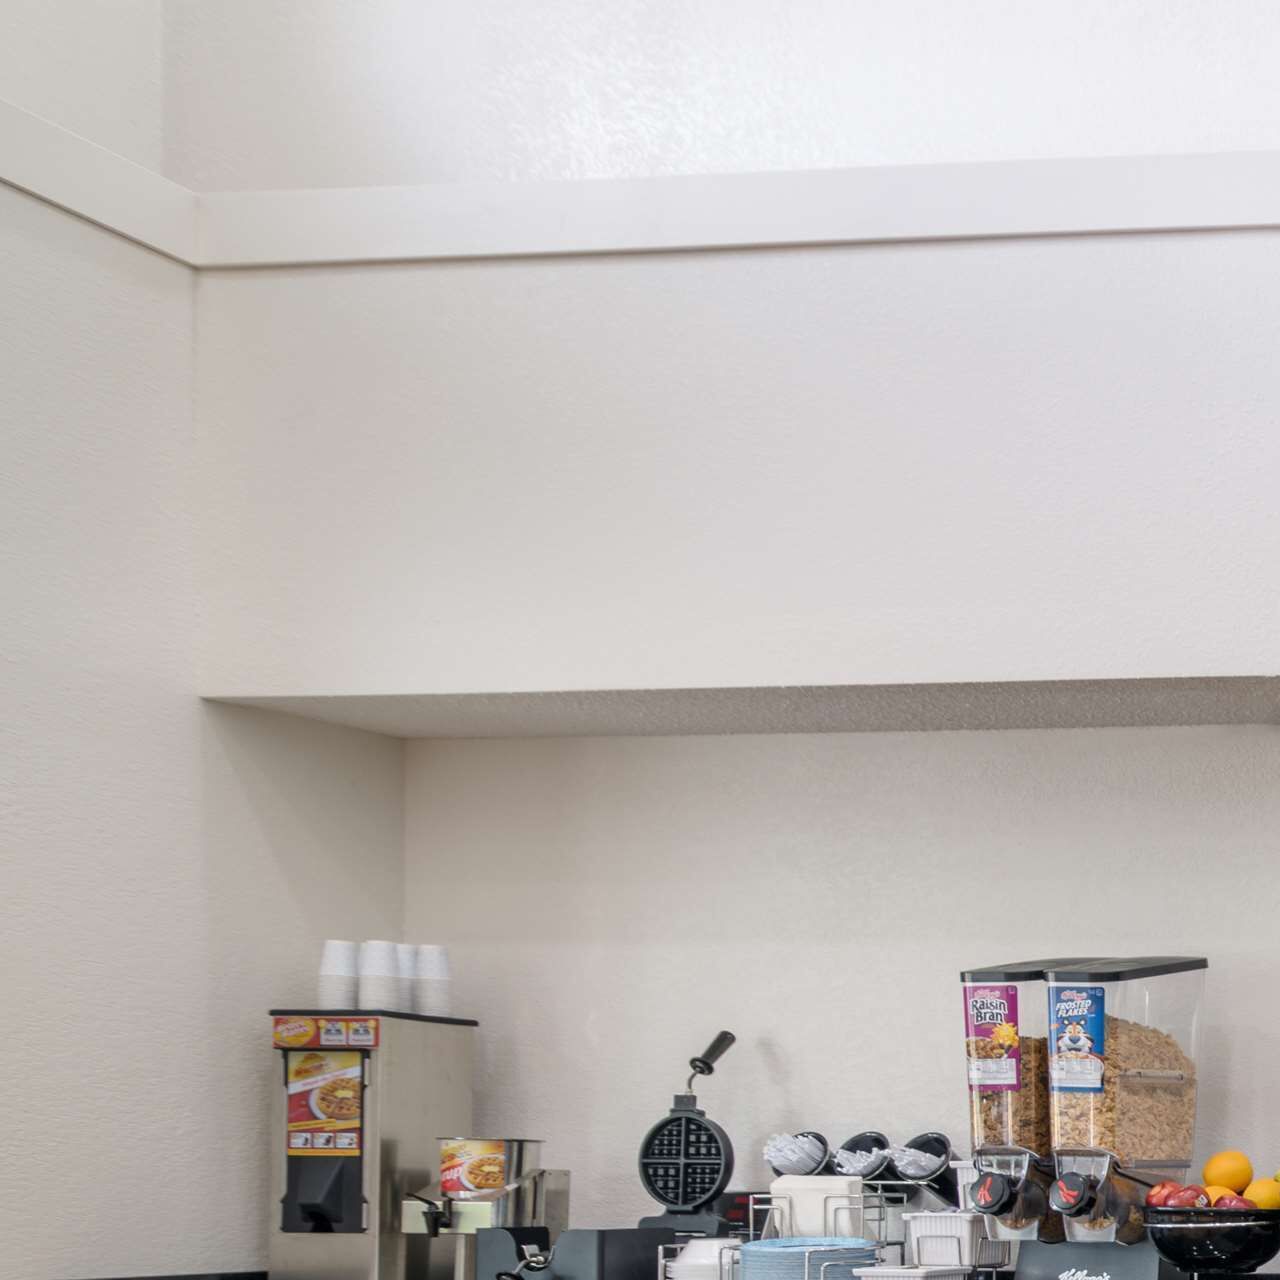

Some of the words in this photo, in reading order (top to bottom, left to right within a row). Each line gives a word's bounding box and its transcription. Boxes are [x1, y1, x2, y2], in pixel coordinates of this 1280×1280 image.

[971, 1000, 1008, 1014] Raisin
[1056, 1000, 1092, 1011] FROSTED
[975, 1011, 1004, 1025] Bran
[1058, 1008, 1088, 1018] FLAKES
[440, 1166, 463, 1180] rup
